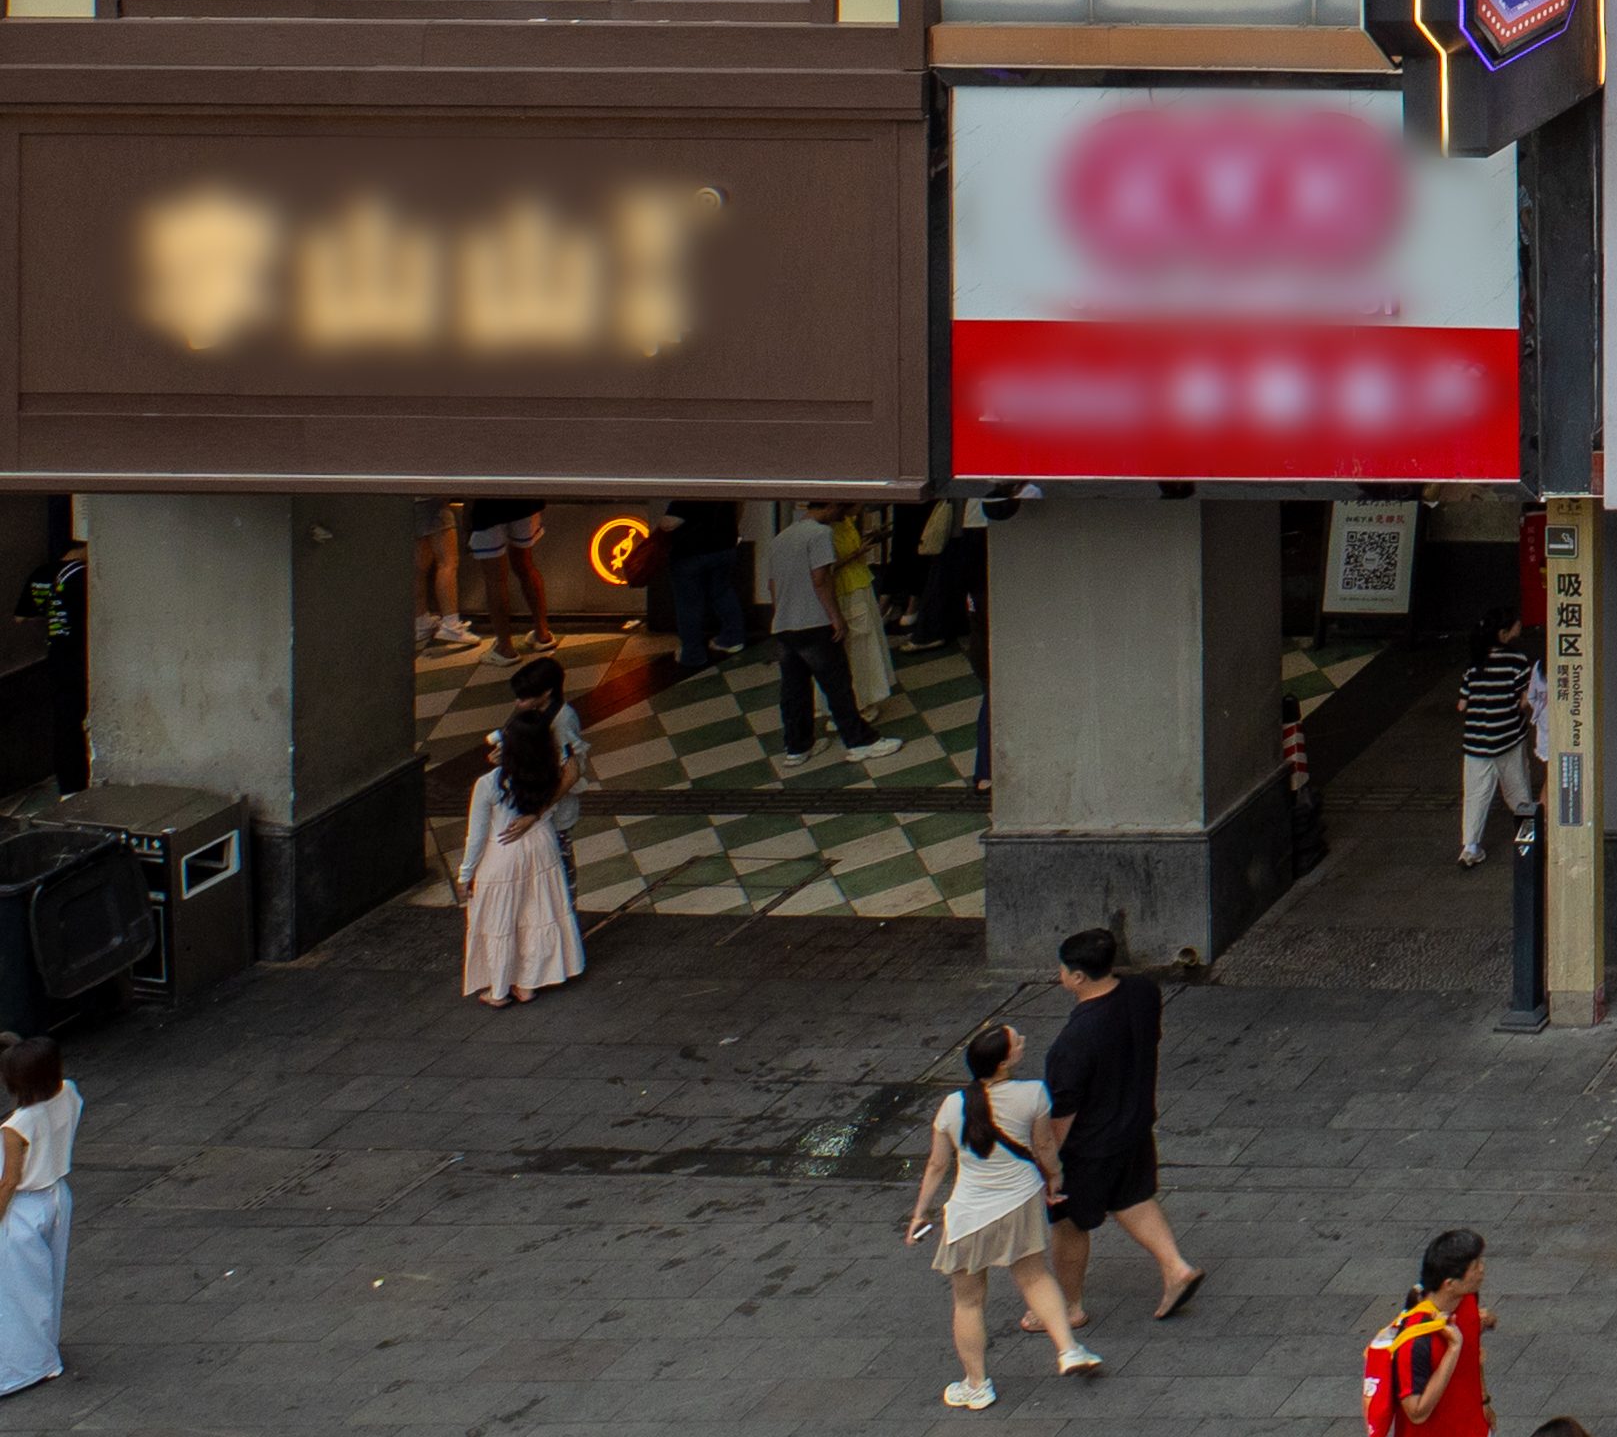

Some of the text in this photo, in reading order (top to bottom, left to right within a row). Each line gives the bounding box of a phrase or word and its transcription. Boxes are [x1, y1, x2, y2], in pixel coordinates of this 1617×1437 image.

[1557, 573, 1582, 657] 吸烟区
[1570, 665, 1583, 747] Smoking Area
